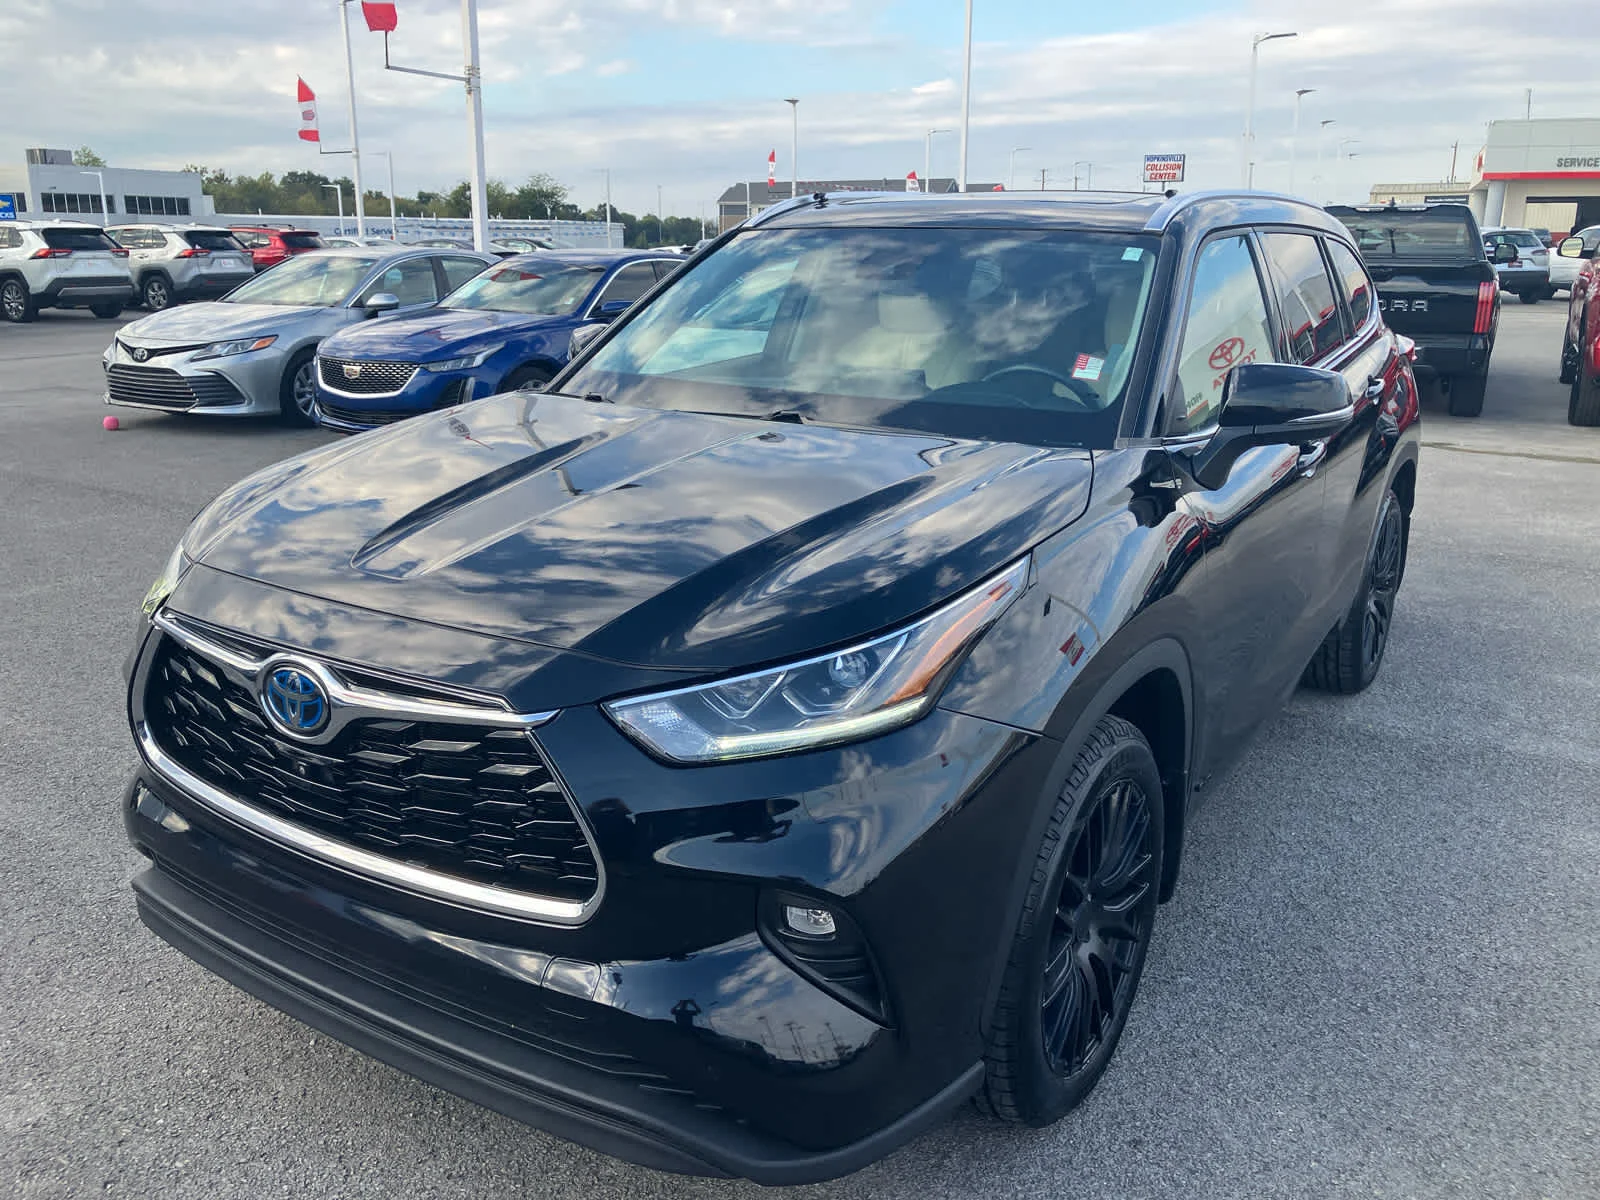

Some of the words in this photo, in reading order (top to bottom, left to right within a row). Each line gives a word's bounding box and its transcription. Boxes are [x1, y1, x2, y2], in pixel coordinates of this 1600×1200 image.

[1556, 157, 1600, 168] SERVICE
[1146, 163, 1181, 171] COLLISION
[1150, 172, 1176, 180] CENTER
